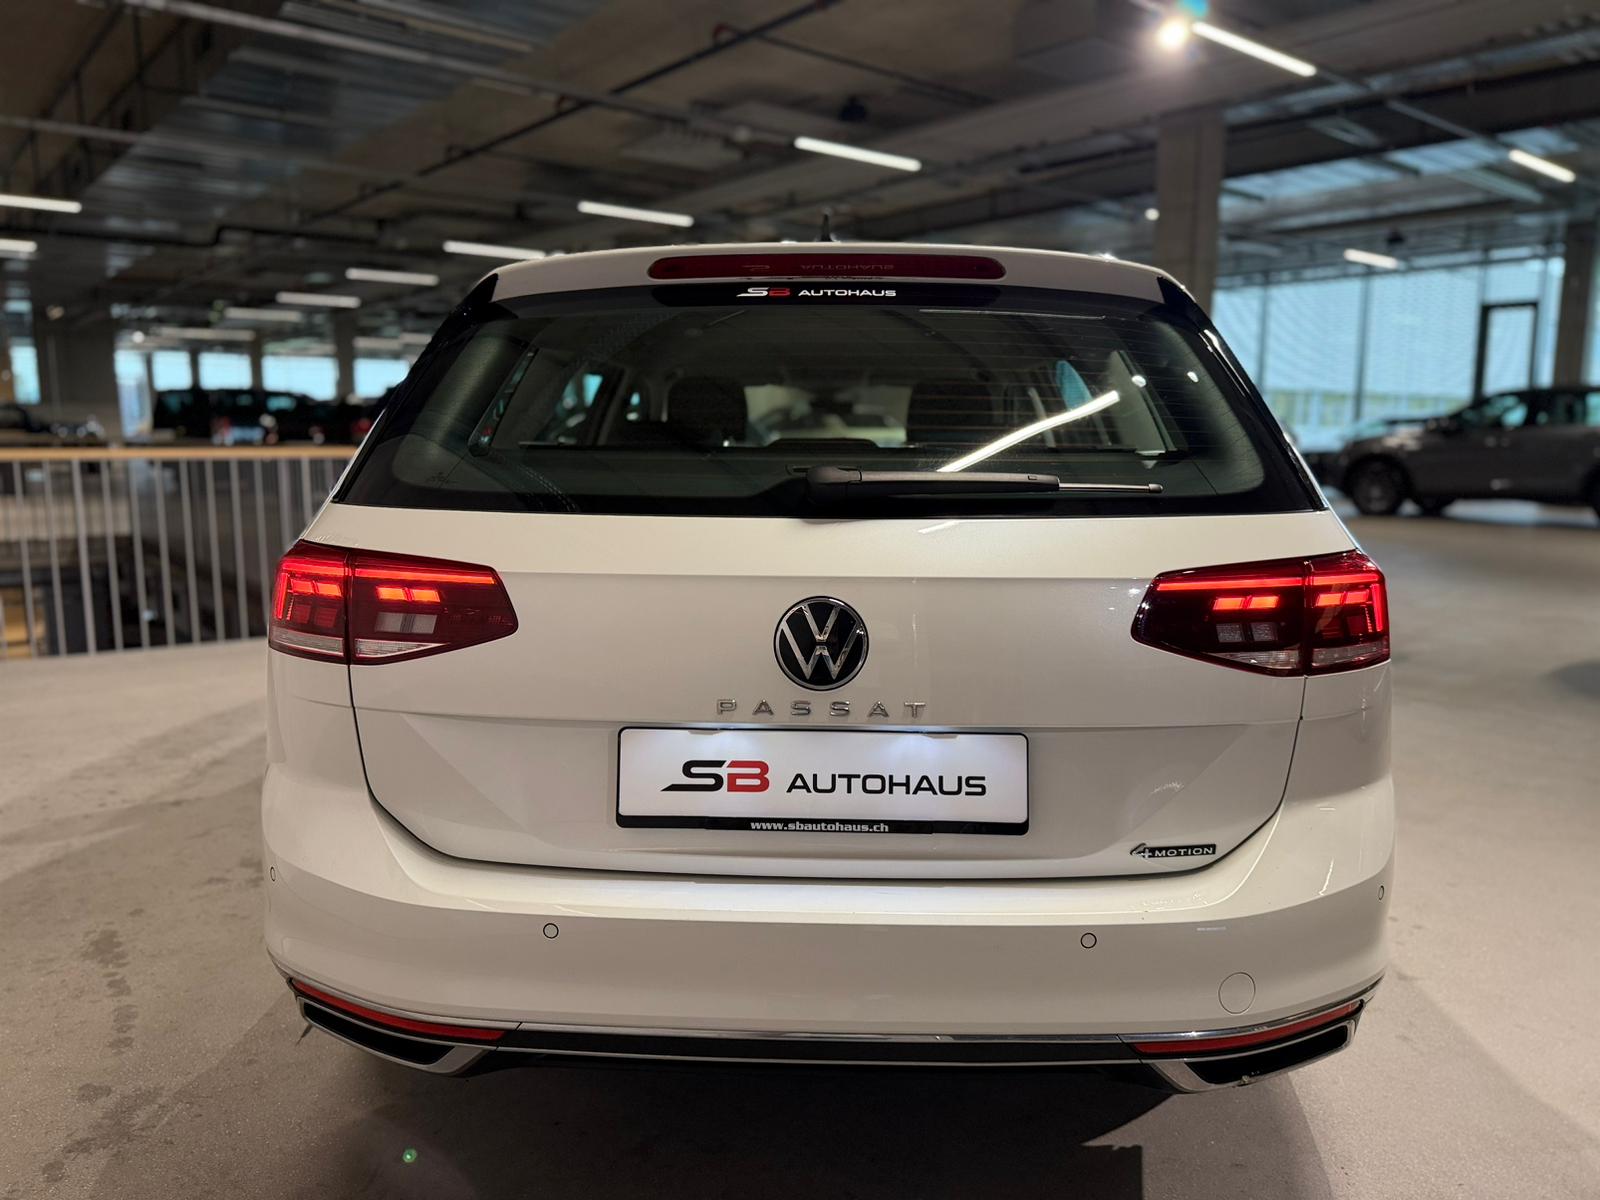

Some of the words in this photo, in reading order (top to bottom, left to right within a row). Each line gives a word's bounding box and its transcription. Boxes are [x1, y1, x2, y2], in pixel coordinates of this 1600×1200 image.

[736, 287, 791, 297] SB
[798, 289, 896, 297] AUTOHAUS
[716, 699, 926, 718] PASSAT
[660, 760, 770, 792] SB
[786, 773, 987, 796] AUTOHAUS
[750, 821, 889, 832] www.sbautohaus.ch
[1130, 843, 1216, 858] 4MOTION
